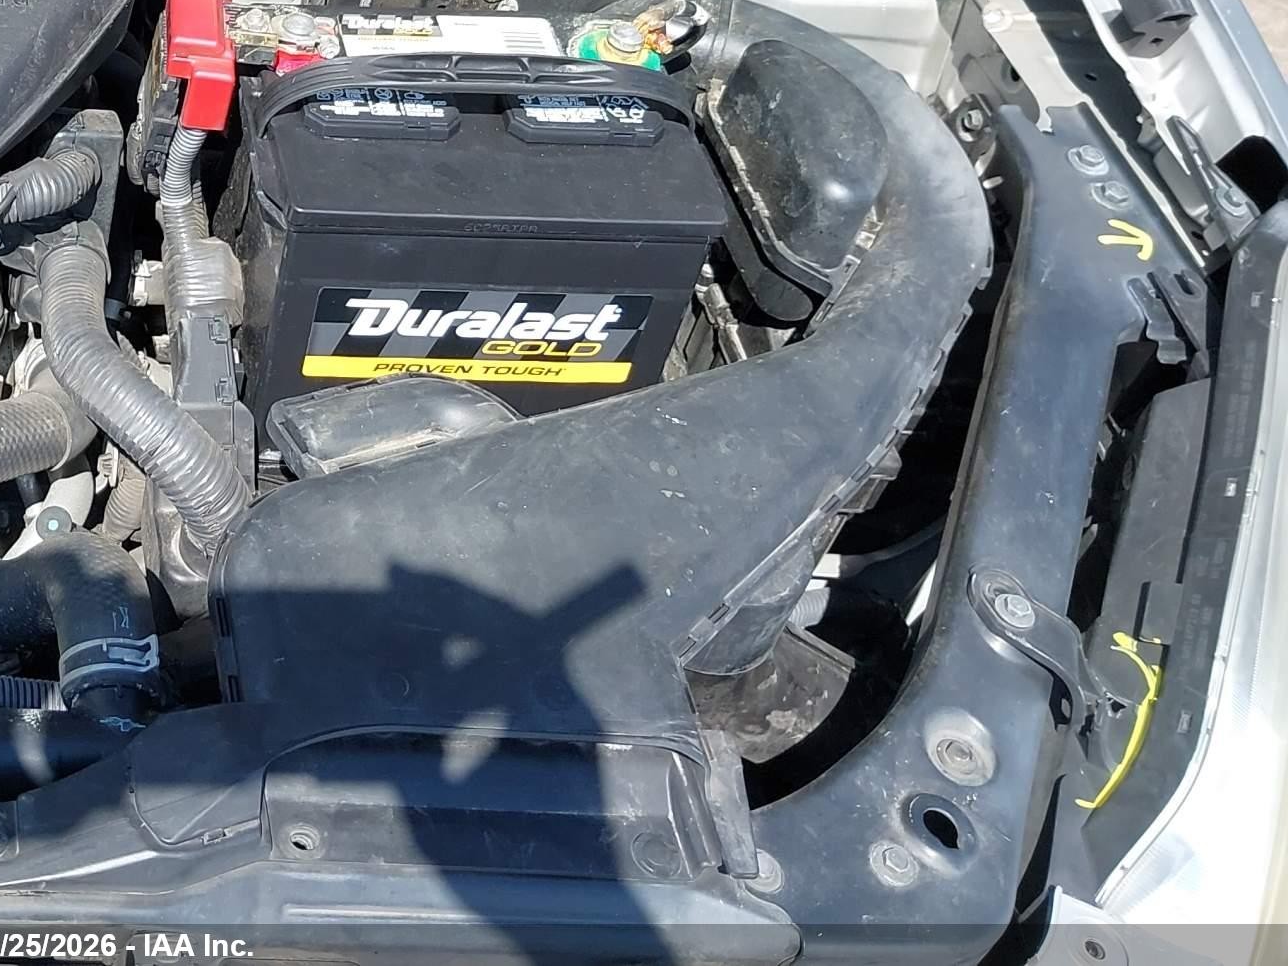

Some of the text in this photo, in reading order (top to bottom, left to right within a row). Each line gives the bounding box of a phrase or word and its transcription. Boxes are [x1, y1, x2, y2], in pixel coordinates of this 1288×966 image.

[345, 299, 622, 340] Duralast
[481, 340, 603, 357] GOLD
[374, 363, 565, 376] PROVEN TOUGH
